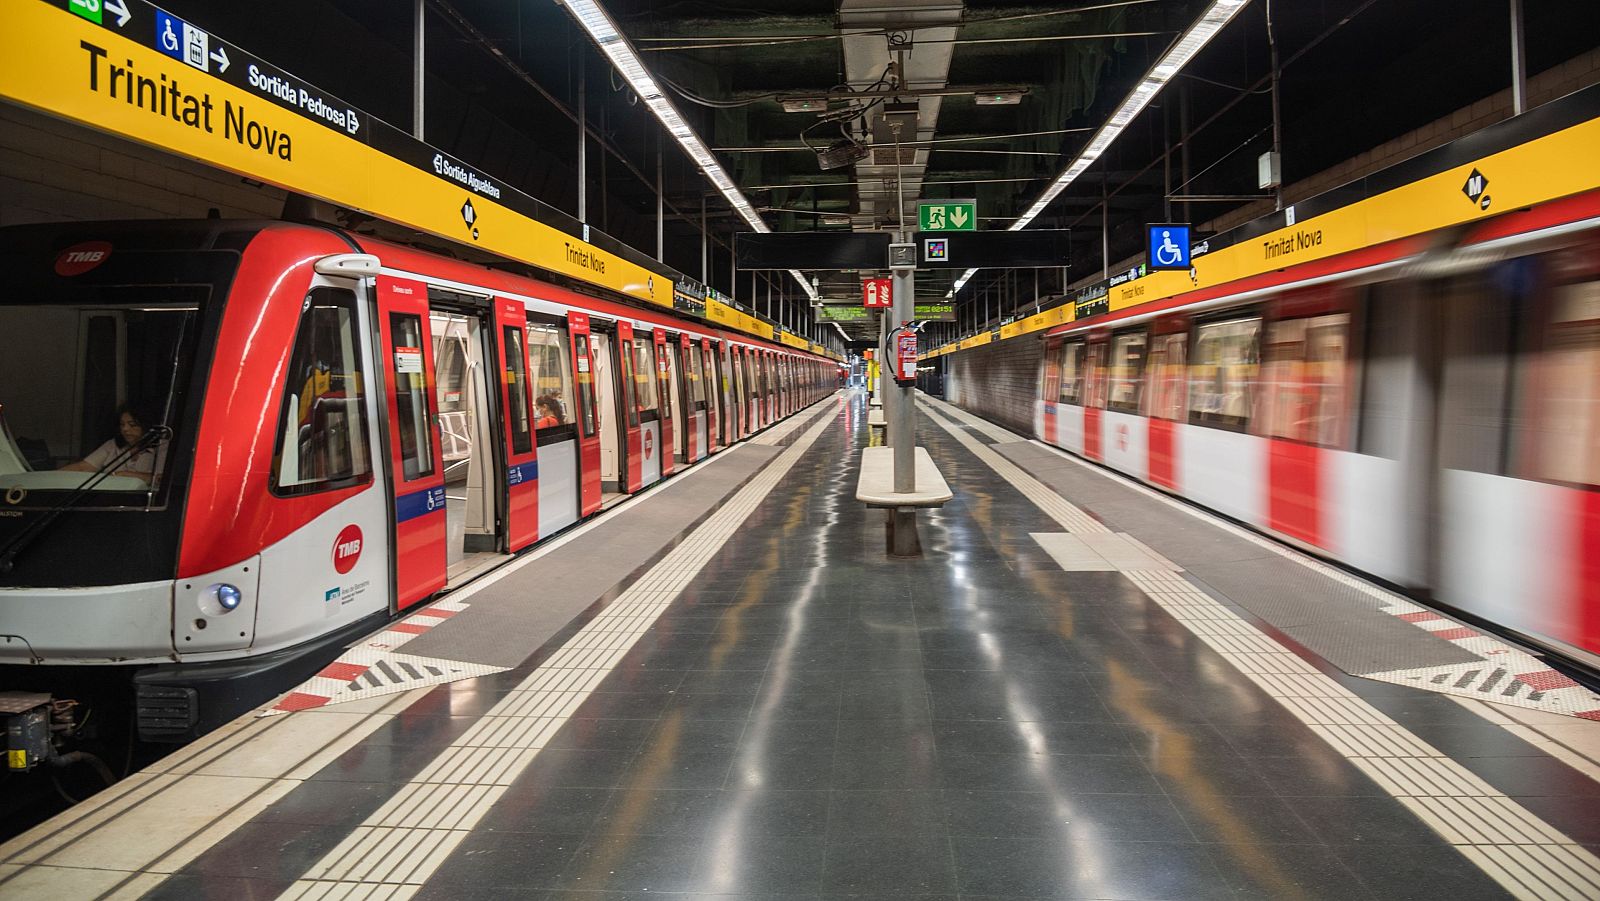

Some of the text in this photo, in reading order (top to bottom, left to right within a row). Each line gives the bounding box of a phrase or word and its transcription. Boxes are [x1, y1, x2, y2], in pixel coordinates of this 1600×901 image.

[80, 39, 293, 162] Trinitat Nova
[248, 64, 346, 128] Sortida Pedrosa
[443, 159, 468, 185] Sortida
[1468, 175, 1482, 197] M
[464, 204, 474, 224] M
[66, 251, 105, 263] TMB
[1263, 230, 1323, 260] Trinitat Nova
[565, 242, 605, 275] Trinitat Nova
[931, 305, 953, 313] 02:51
[338, 539, 361, 559] TMB
